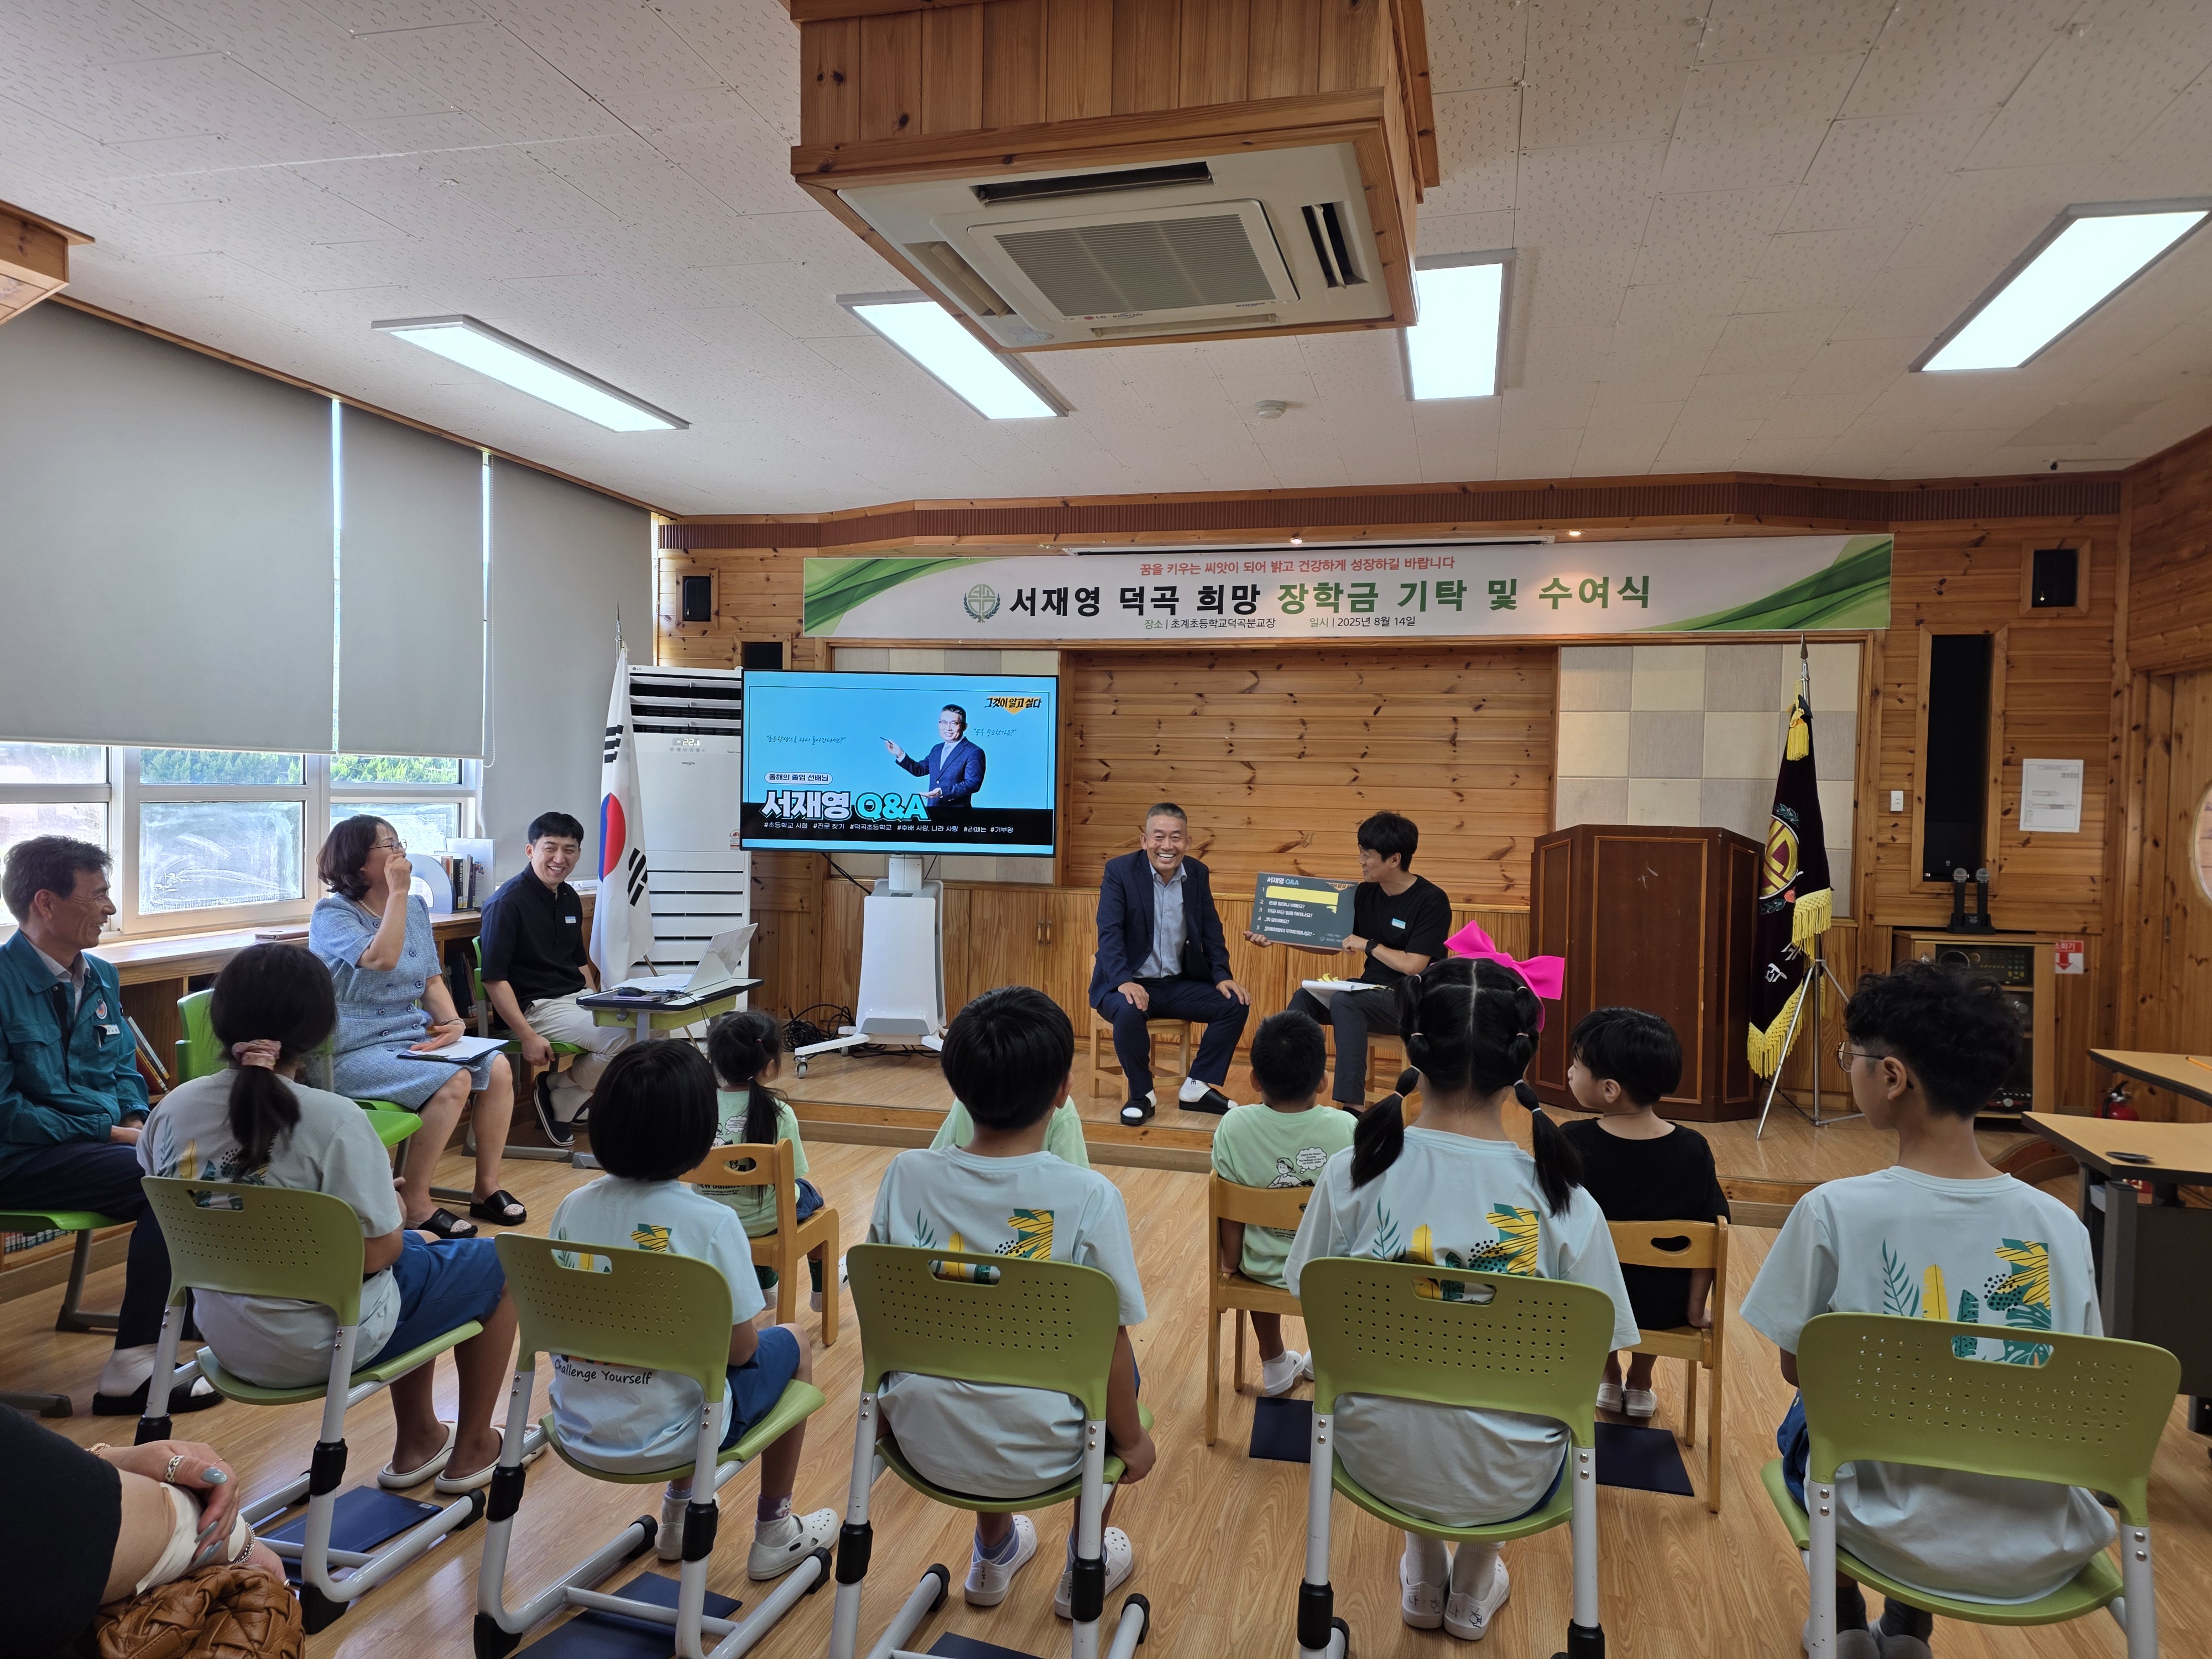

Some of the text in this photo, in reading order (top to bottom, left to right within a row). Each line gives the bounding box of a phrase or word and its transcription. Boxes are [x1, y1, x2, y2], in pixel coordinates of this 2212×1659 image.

[1140, 556, 1455, 576] 꿈을 키우는 씨앗이 되어 밝고 건강하게 성장하길 바랍니다
[1009, 576, 1650, 617] 서재영 덕곡 희망 장학금 기탁 및 수여식
[1144, 618, 1276, 629] 장소 초계초등학교덕곡분교장
[1310, 615, 1416, 628] 일시 2025년 8월 14일
[984, 697, 1042, 708] 그것이 알고 싶다
[761, 790, 930, 821] 서재영 Q&A
[2056, 942, 2075, 951] 소화기
[555, 1359, 653, 1385] Challenge Yourself
